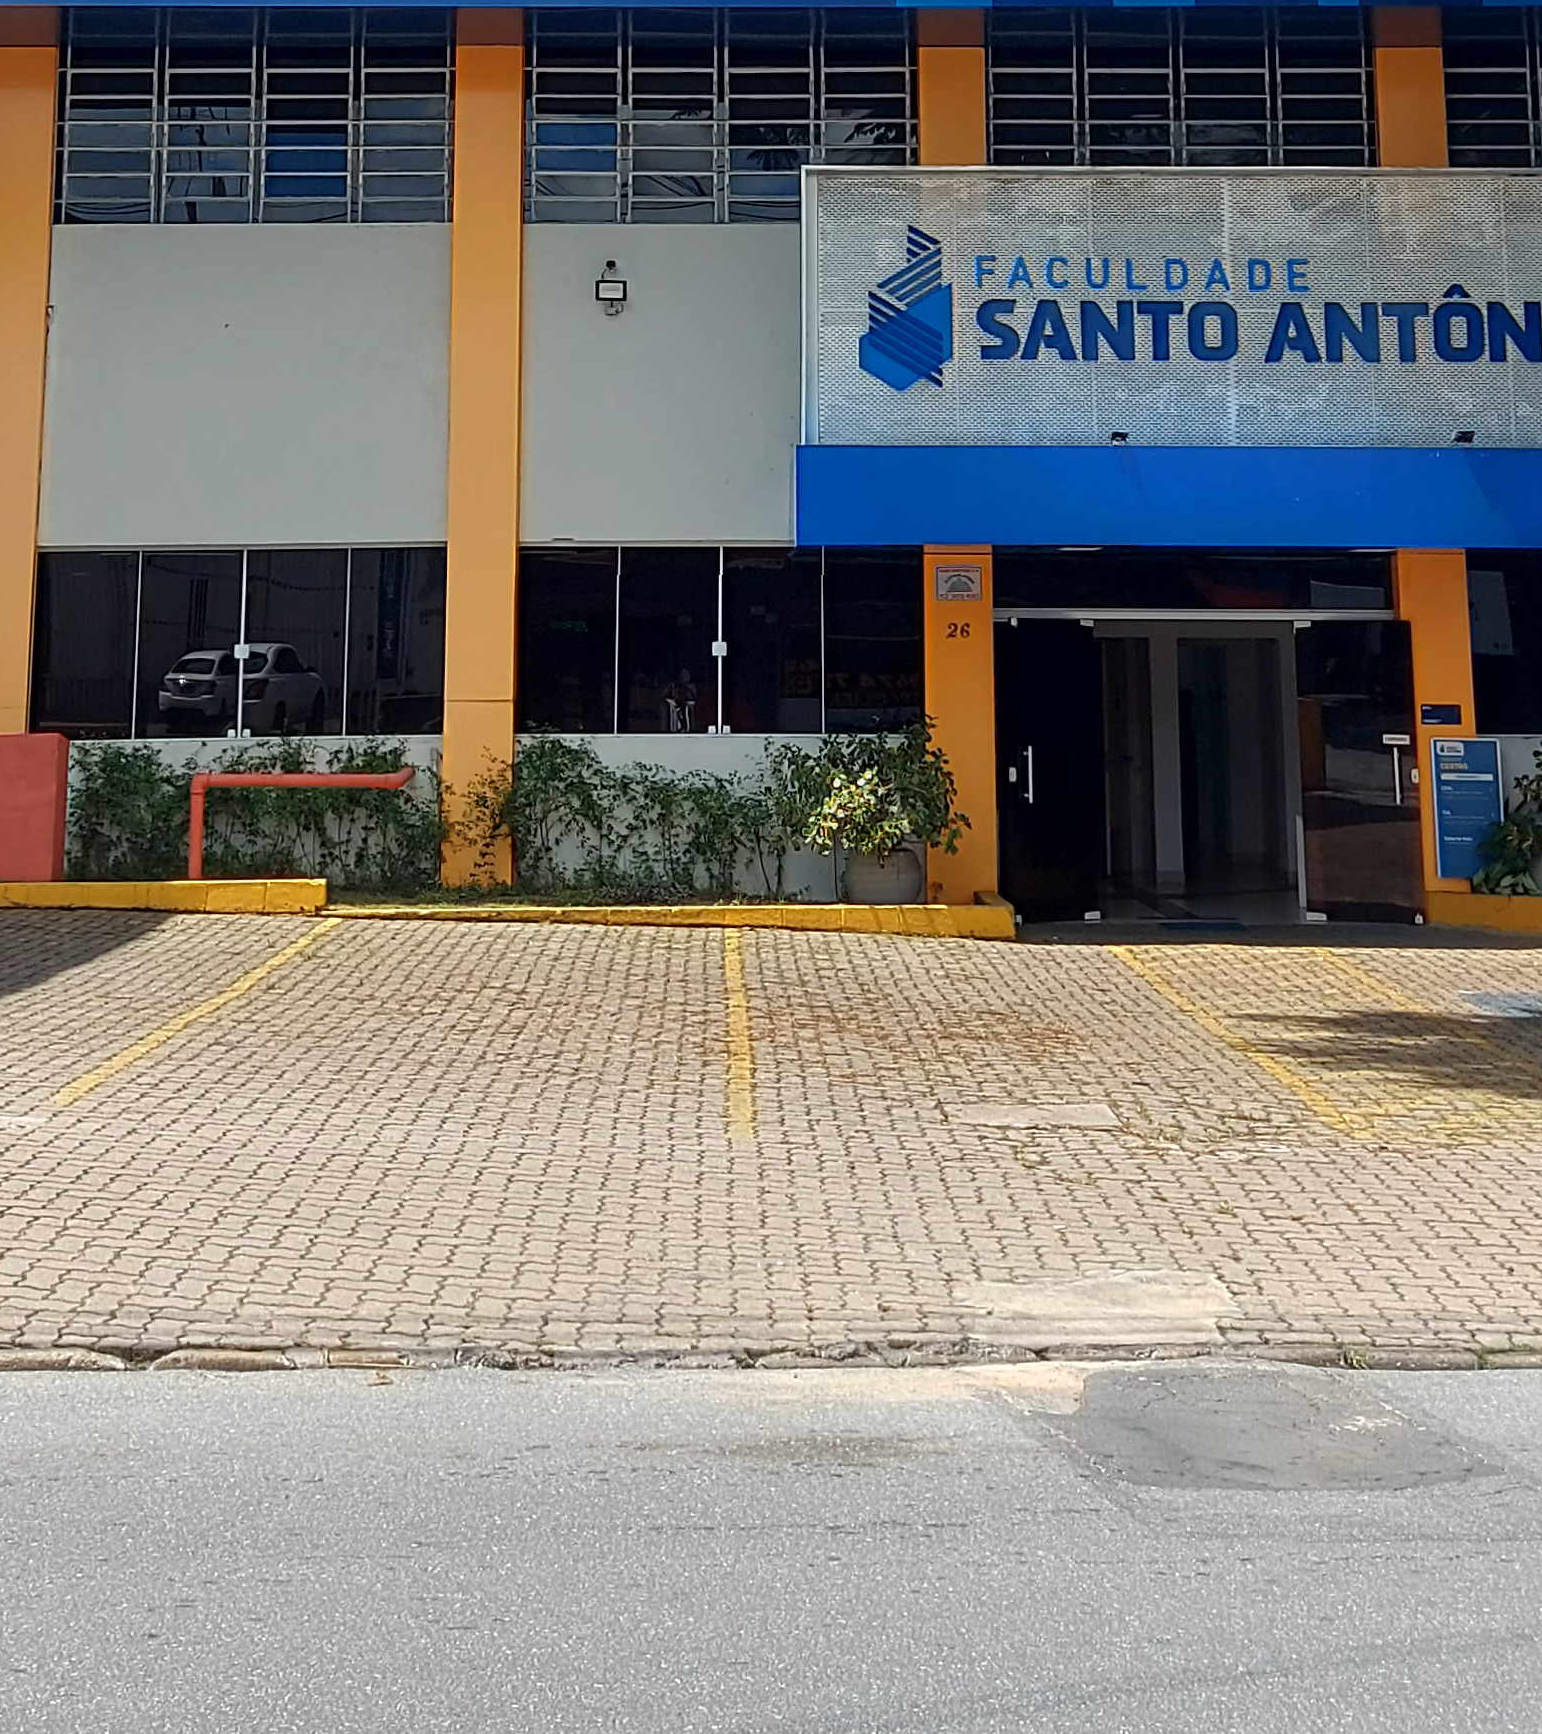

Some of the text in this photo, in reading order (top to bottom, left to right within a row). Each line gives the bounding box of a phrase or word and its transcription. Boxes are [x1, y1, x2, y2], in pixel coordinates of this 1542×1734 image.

[974, 255, 1311, 292] FACULDADE
[976, 299, 1239, 363] SANTO
[945, 622, 971, 640] 26
